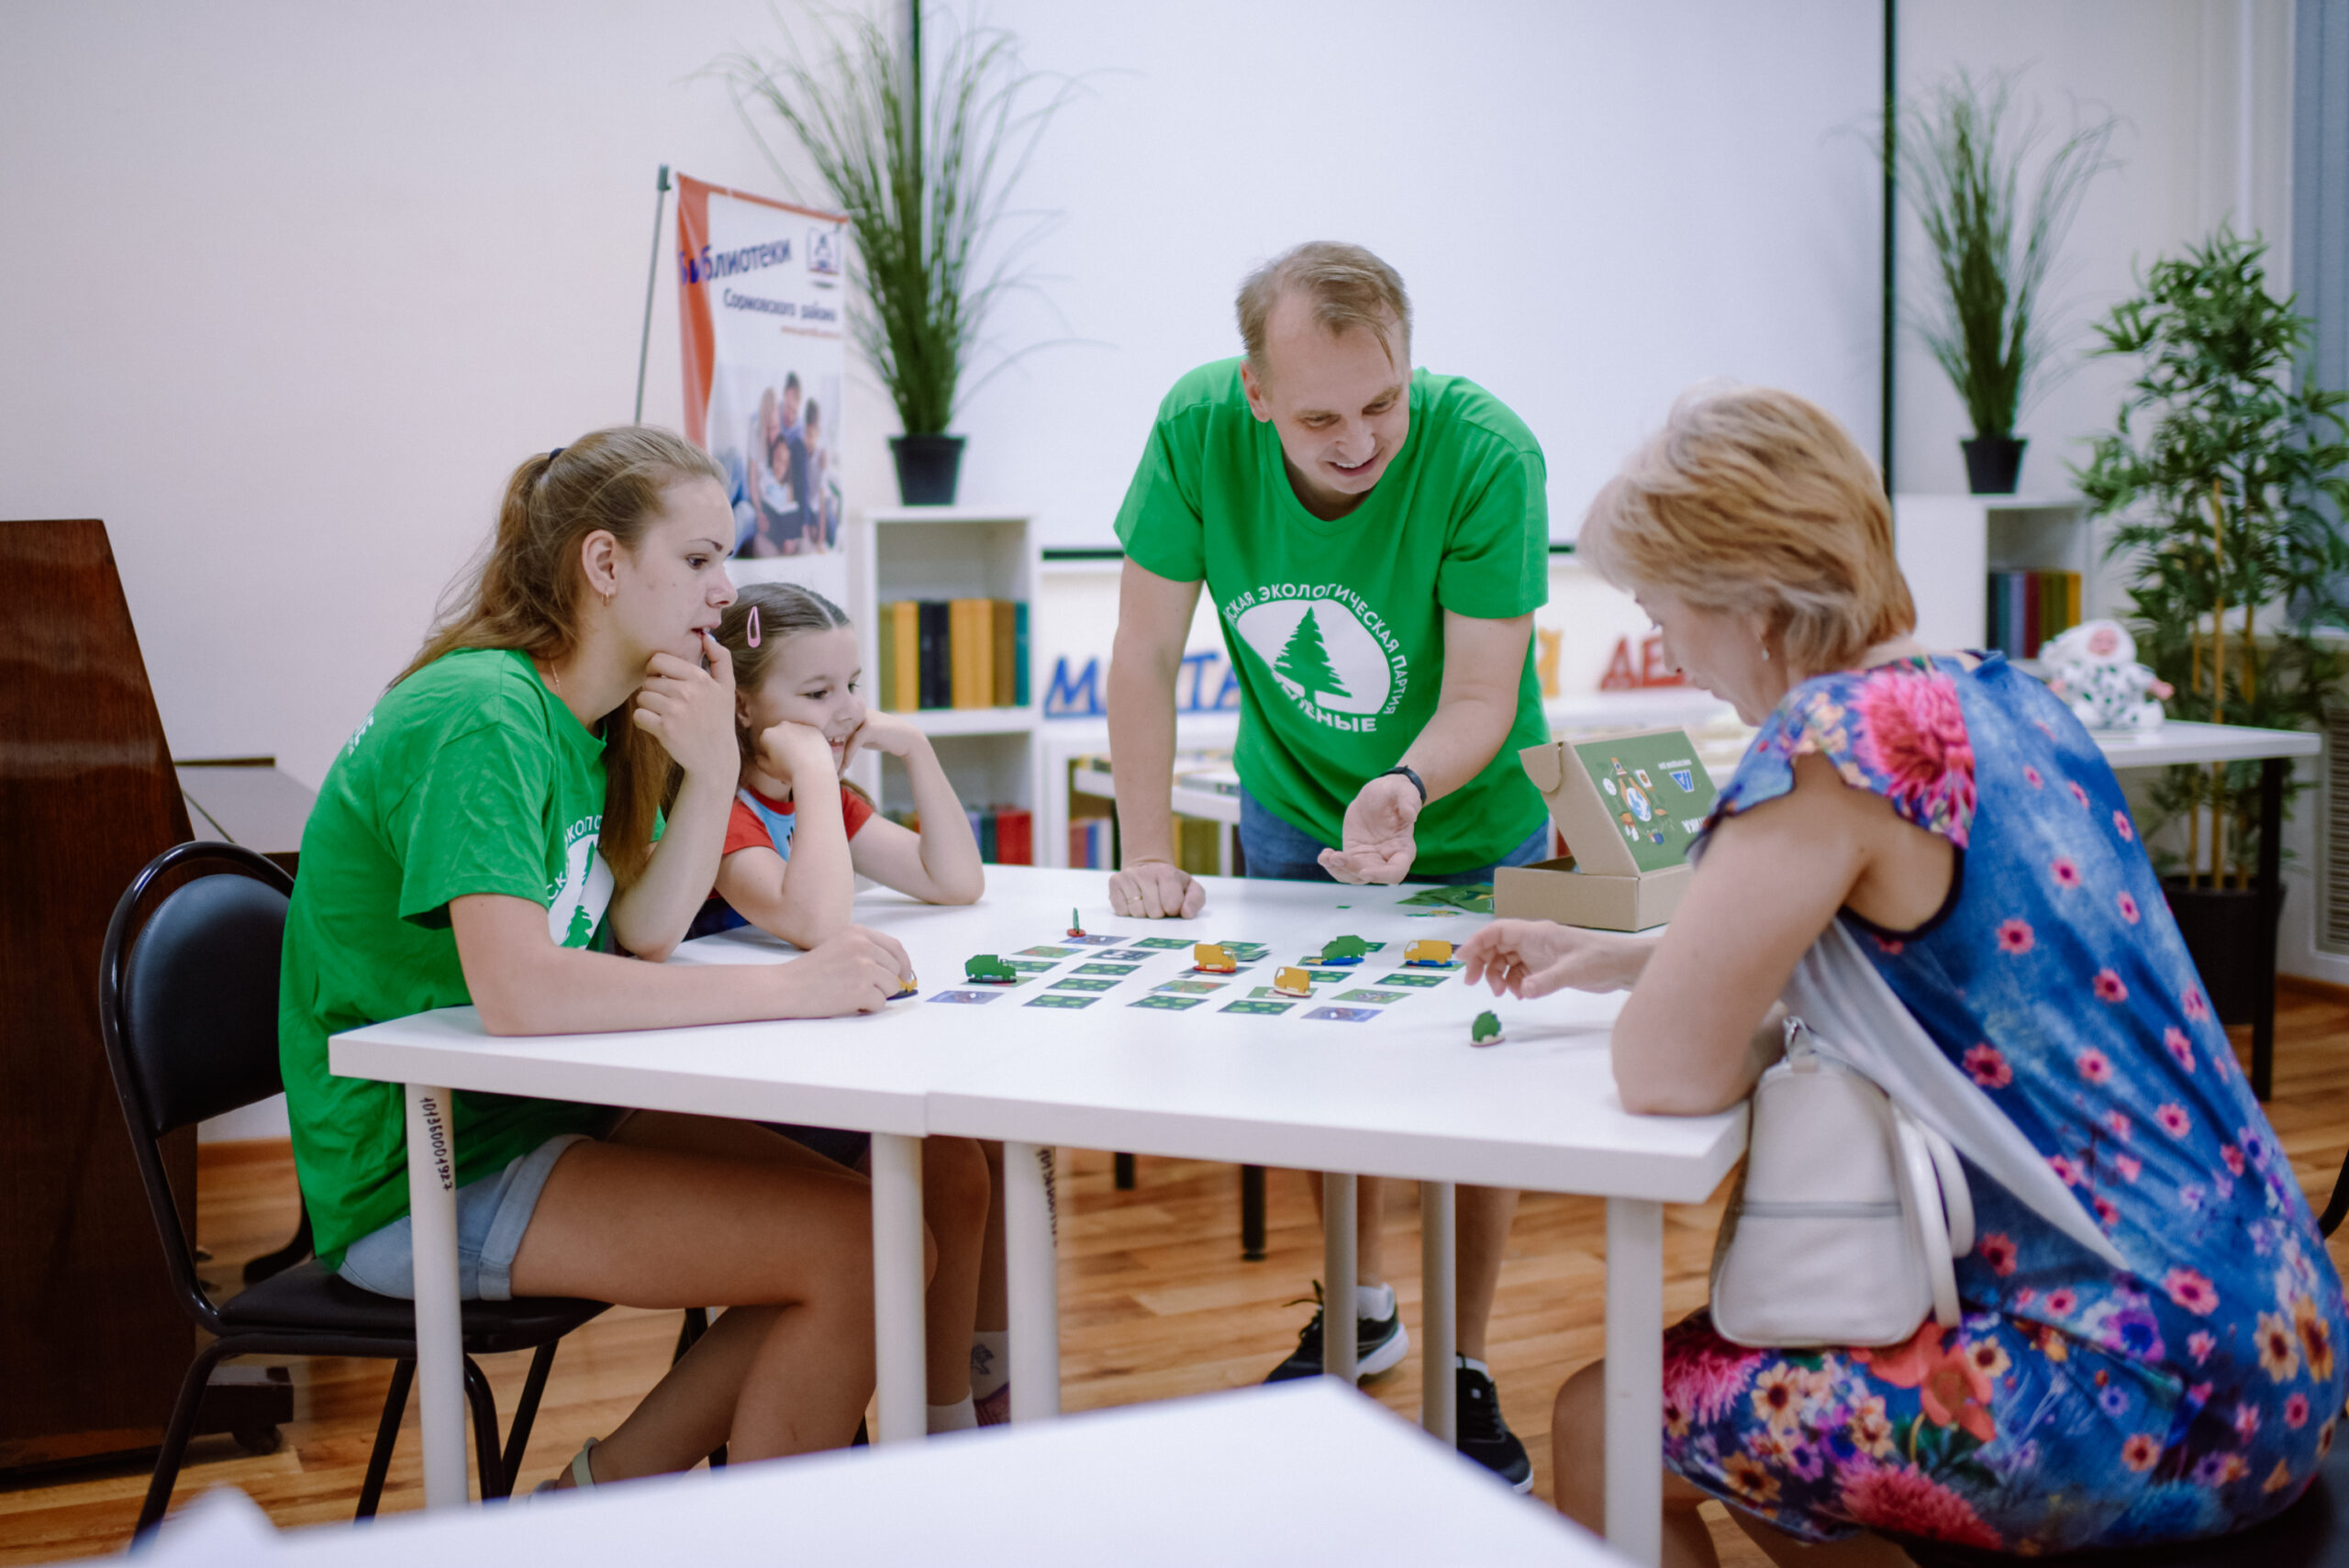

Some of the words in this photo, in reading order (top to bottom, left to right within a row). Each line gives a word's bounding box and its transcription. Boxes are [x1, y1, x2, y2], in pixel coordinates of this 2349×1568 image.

[1223, 590, 1256, 619] СКАЯ
[1258, 583, 1400, 654] ЭКОЛОГИЧЕСКАЯ
[1383, 654, 1408, 715] ПАРТИЯ
